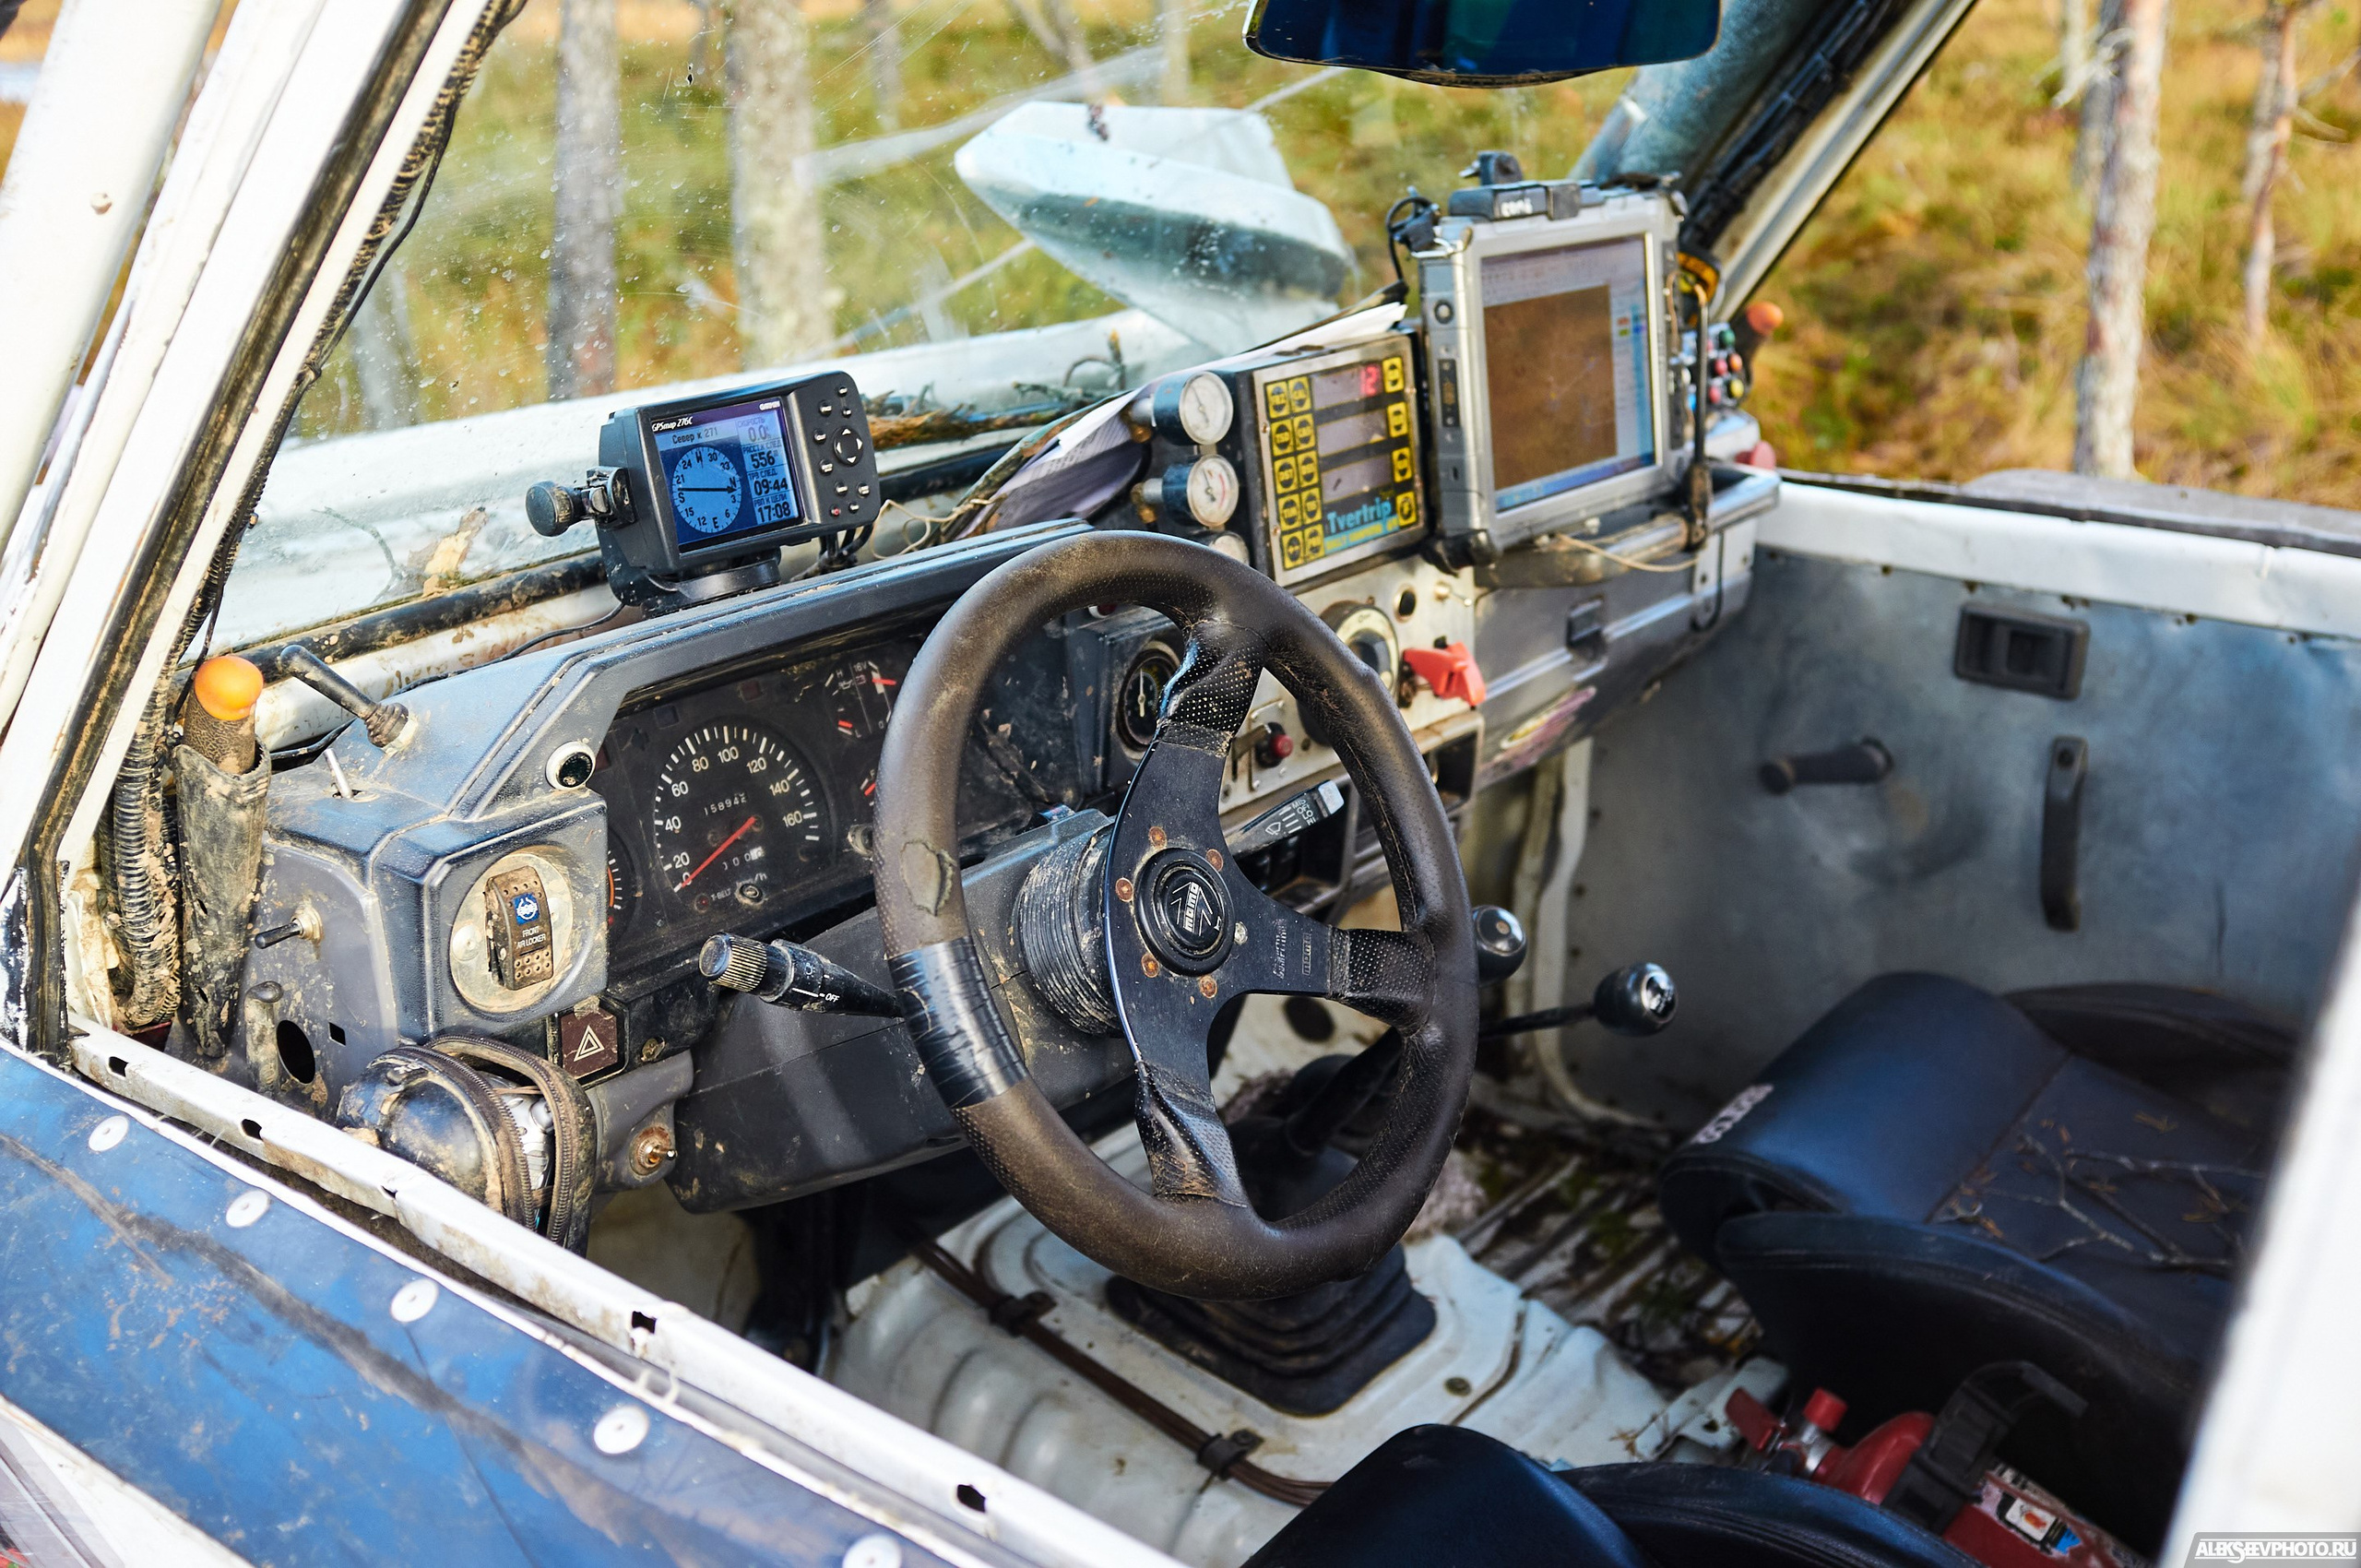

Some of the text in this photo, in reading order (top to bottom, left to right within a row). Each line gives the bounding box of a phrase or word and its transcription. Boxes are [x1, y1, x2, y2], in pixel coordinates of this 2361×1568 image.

[652, 416, 694, 433] GPSmap 276C
[672, 434, 694, 445] Север
[704, 428, 718, 438] 271
[748, 425, 767, 443] 0.0
[682, 459, 692, 469] 24
[707, 452, 718, 462] 30
[750, 450, 776, 469] 556
[720, 461, 730, 470] 33
[675, 474, 685, 484] 21
[753, 478, 788, 496] 09:44
[678, 493, 685, 504] S
[731, 494, 737, 504] 3
[684, 507, 694, 517] 15
[725, 509, 730, 517] 6
[757, 501, 790, 523] 17:08
[1327, 496, 1393, 533] Tvertrip
[697, 517, 707, 526] 12
[712, 517, 718, 529] E
[718, 746, 739, 763] 100
[692, 756, 709, 772] 80
[746, 756, 767, 774] 120
[671, 781, 689, 797] 60
[769, 779, 789, 796] 140
[665, 815, 682, 831] 40
[782, 811, 802, 827] 160
[1302, 810, 1313, 820] LO
[673, 851, 690, 869] 20
[682, 872, 692, 885] 0
[1184, 881, 1200, 932] momo
[522, 926, 540, 937] FRONT
[526, 933, 546, 946] LOCKER
[825, 992, 839, 1003] OFF
